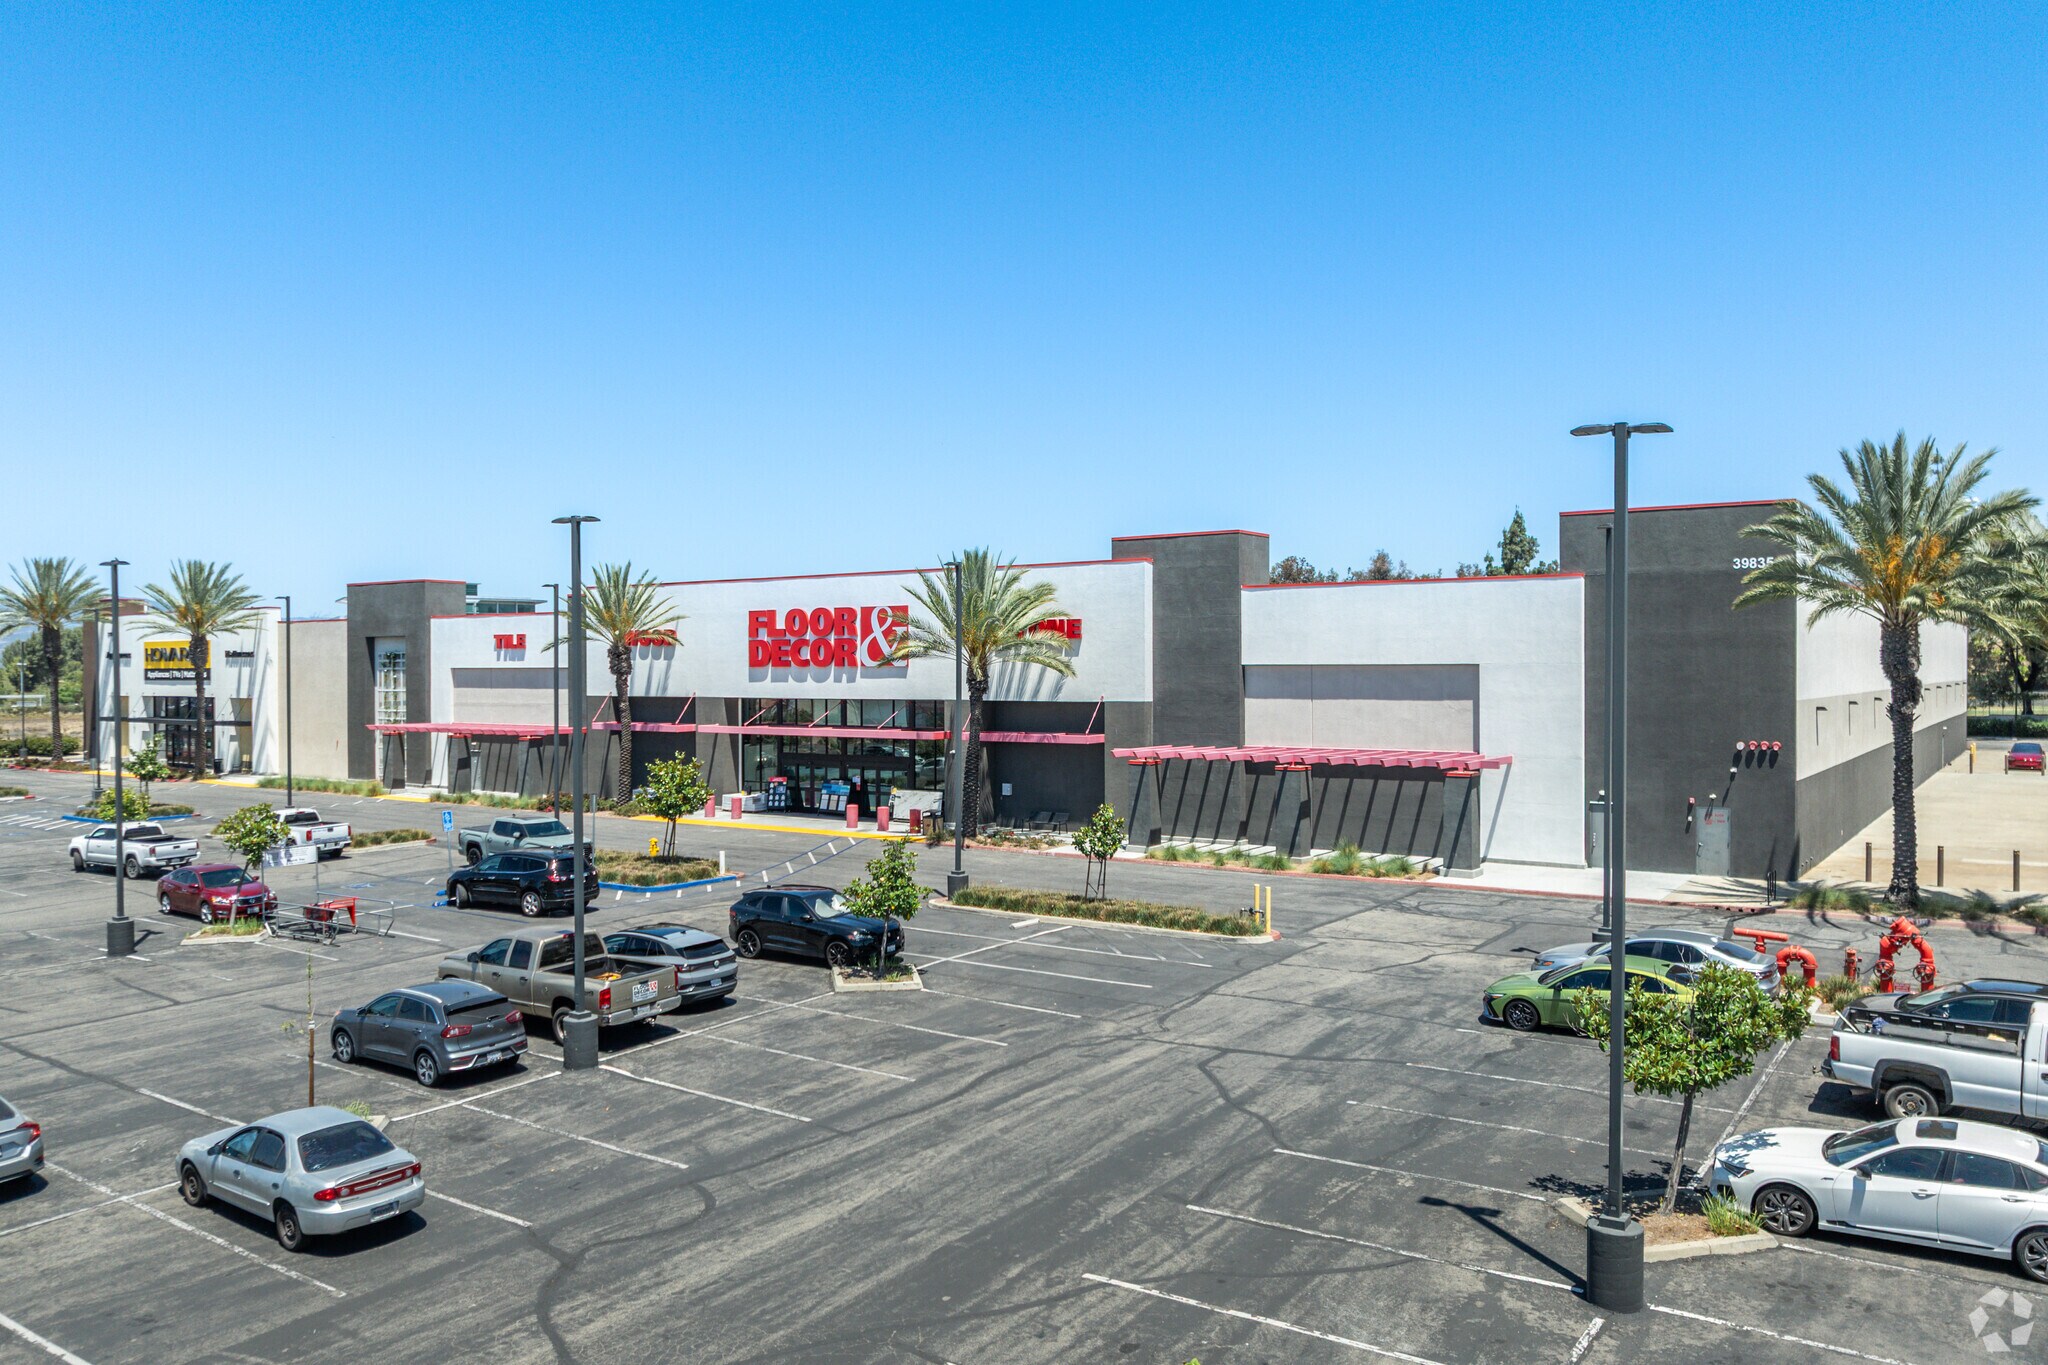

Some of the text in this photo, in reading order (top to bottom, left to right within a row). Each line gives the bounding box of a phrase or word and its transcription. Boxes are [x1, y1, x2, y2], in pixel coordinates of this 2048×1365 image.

[1732, 556, 1774, 569] 39835
[748, 607, 858, 638] FLOOR
[493, 633, 527, 649] TILE
[861, 606, 907, 667] &
[145, 647, 192, 662] HOWAR
[748, 637, 859, 668] DECOR
